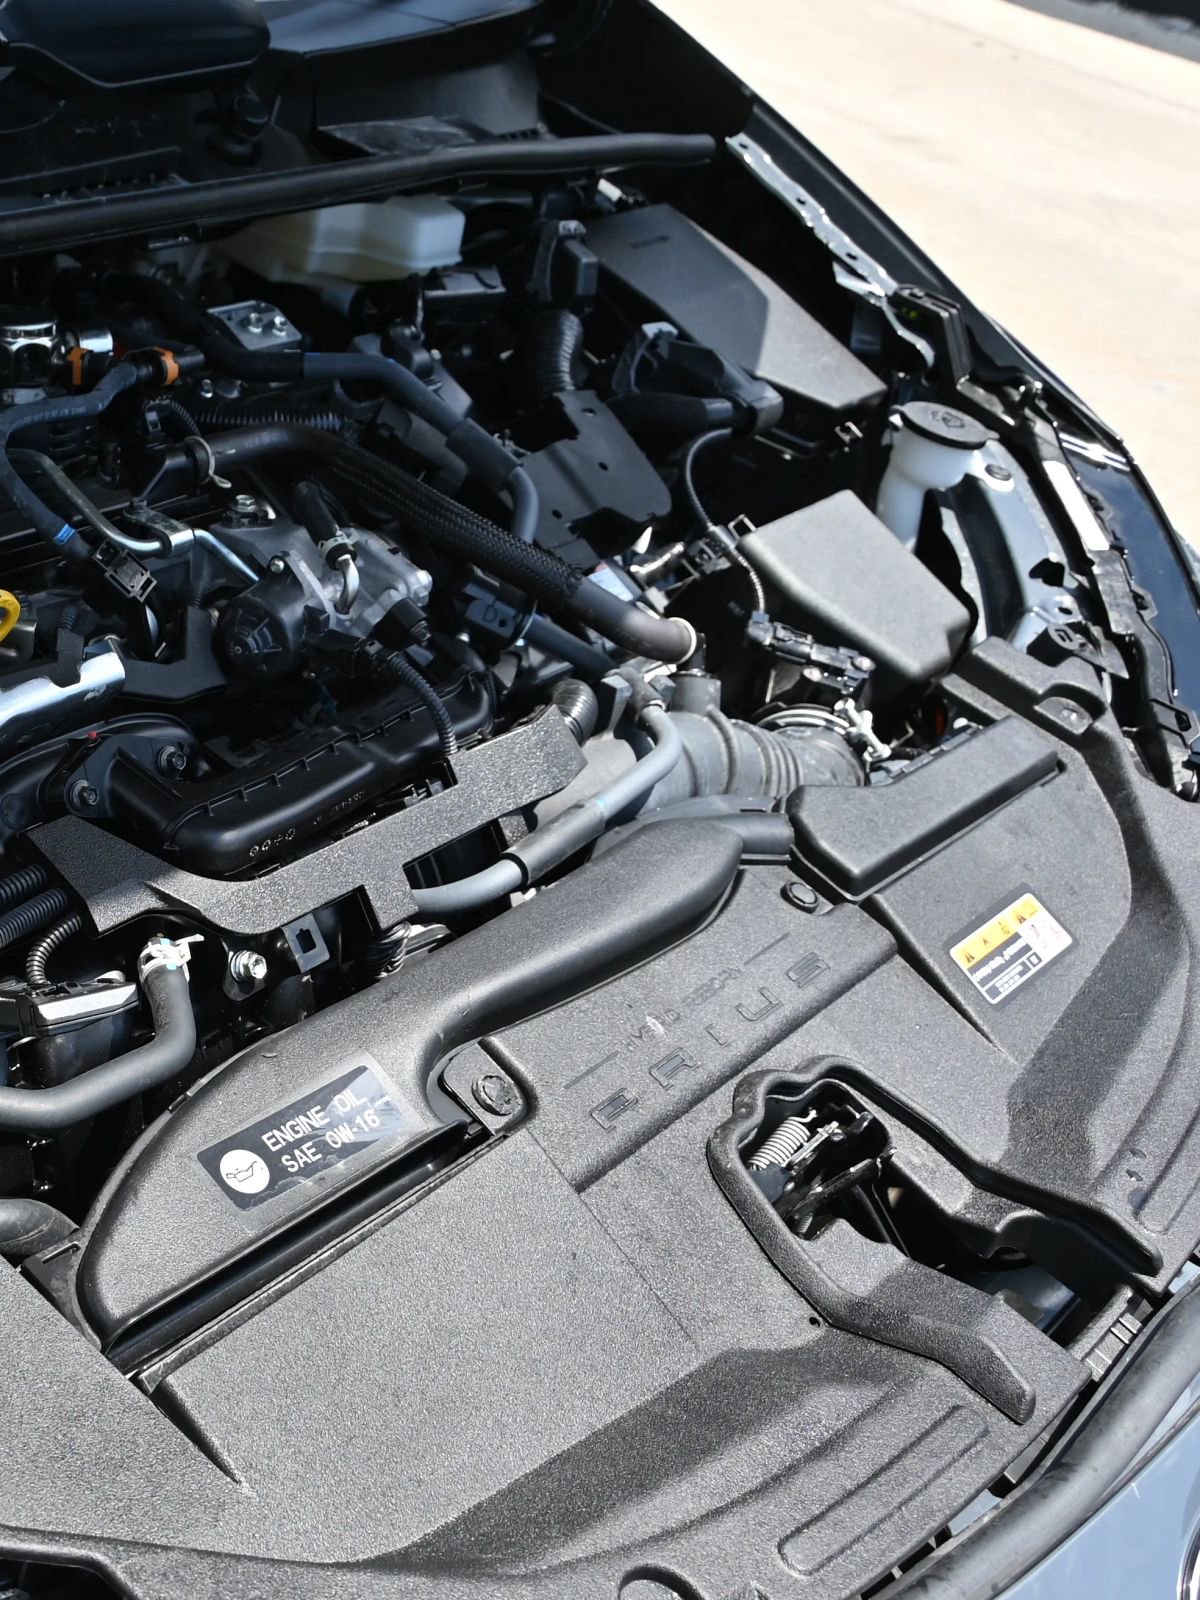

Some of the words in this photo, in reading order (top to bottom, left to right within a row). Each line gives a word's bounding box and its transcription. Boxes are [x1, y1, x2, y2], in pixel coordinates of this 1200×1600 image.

[590, 952, 831, 1132] PRIUS
[261, 1105, 330, 1152] ENGINE
[333, 1089, 368, 1114] OIL
[281, 1142, 323, 1173] SAE
[325, 1109, 381, 1149] 0W-16
